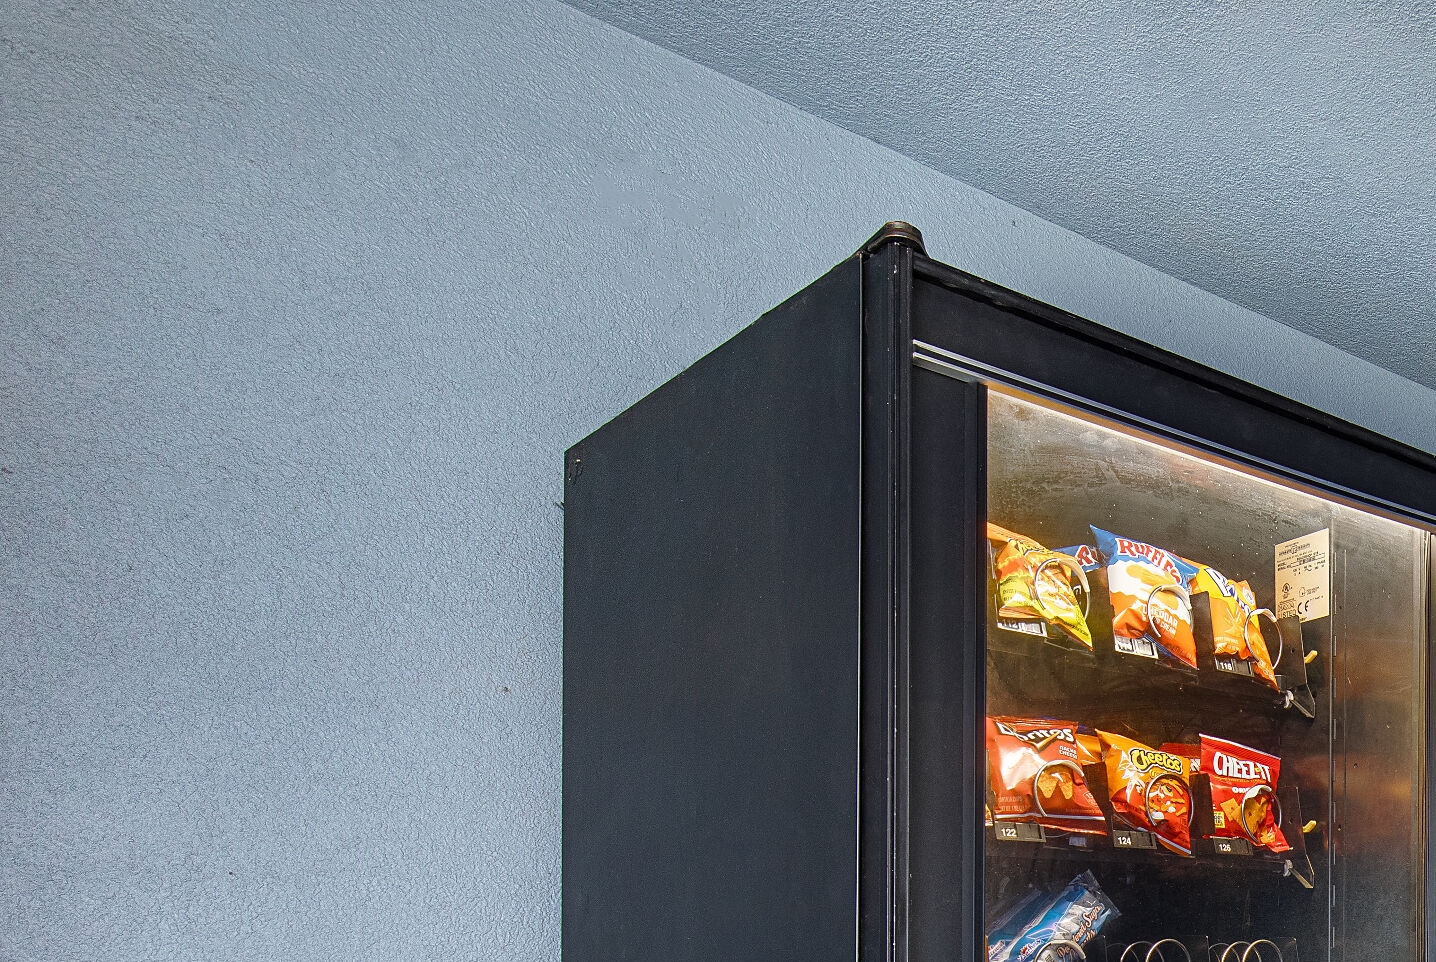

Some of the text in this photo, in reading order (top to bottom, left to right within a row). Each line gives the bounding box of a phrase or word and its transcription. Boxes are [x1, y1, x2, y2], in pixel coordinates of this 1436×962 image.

[1130, 749, 1184, 774] Cheetos
[1001, 828, 1017, 837] 122
[1117, 837, 1132, 846] 124
